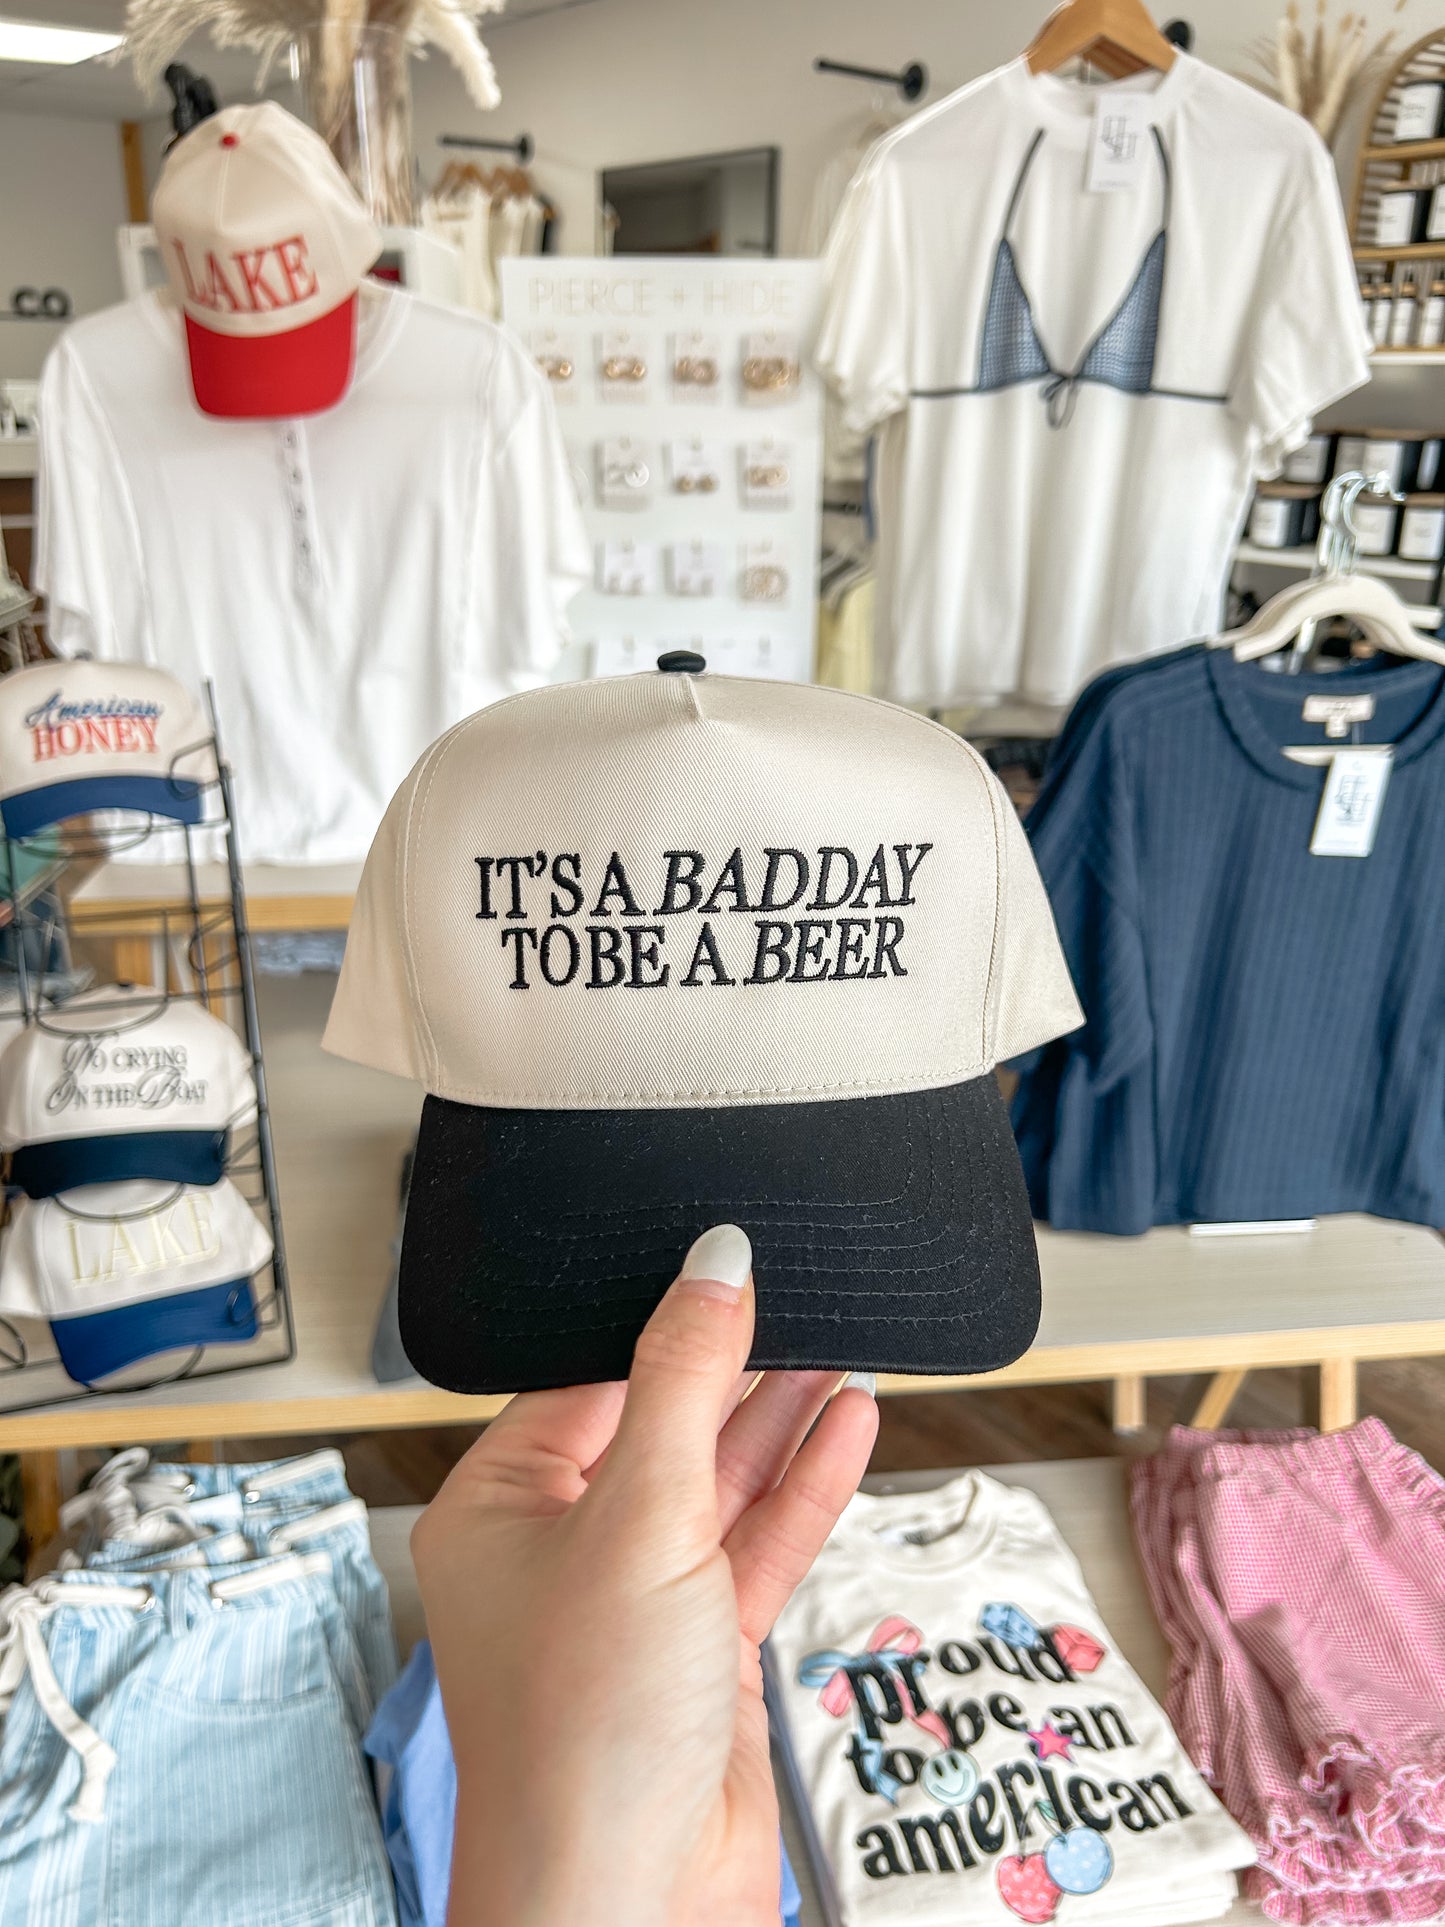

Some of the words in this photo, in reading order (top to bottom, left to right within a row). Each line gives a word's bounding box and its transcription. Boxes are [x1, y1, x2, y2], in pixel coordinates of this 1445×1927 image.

[172, 233, 320, 314] LAKE
[528, 277, 655, 317] PIERCE
[702, 278, 794, 317] HIDE
[24, 687, 163, 730] American
[33, 714, 160, 763] HONEY
[474, 850, 584, 919] IT'S
[589, 852, 646, 917] A
[653, 847, 811, 916] BAD
[806, 843, 934, 912] DAY
[502, 923, 582, 989] TO
[585, 924, 670, 989] BE
[680, 921, 736, 987] A
[743, 916, 909, 986] BEER
[111, 1045, 188, 1075] CRYING
[64, 1191, 222, 1289] LAKE
[845, 1626, 1076, 1740] proud
[845, 1732, 925, 1796] to
[938, 1689, 1031, 1750] be
[1050, 1701, 1140, 1752] an
[856, 1755, 1198, 1880] american
